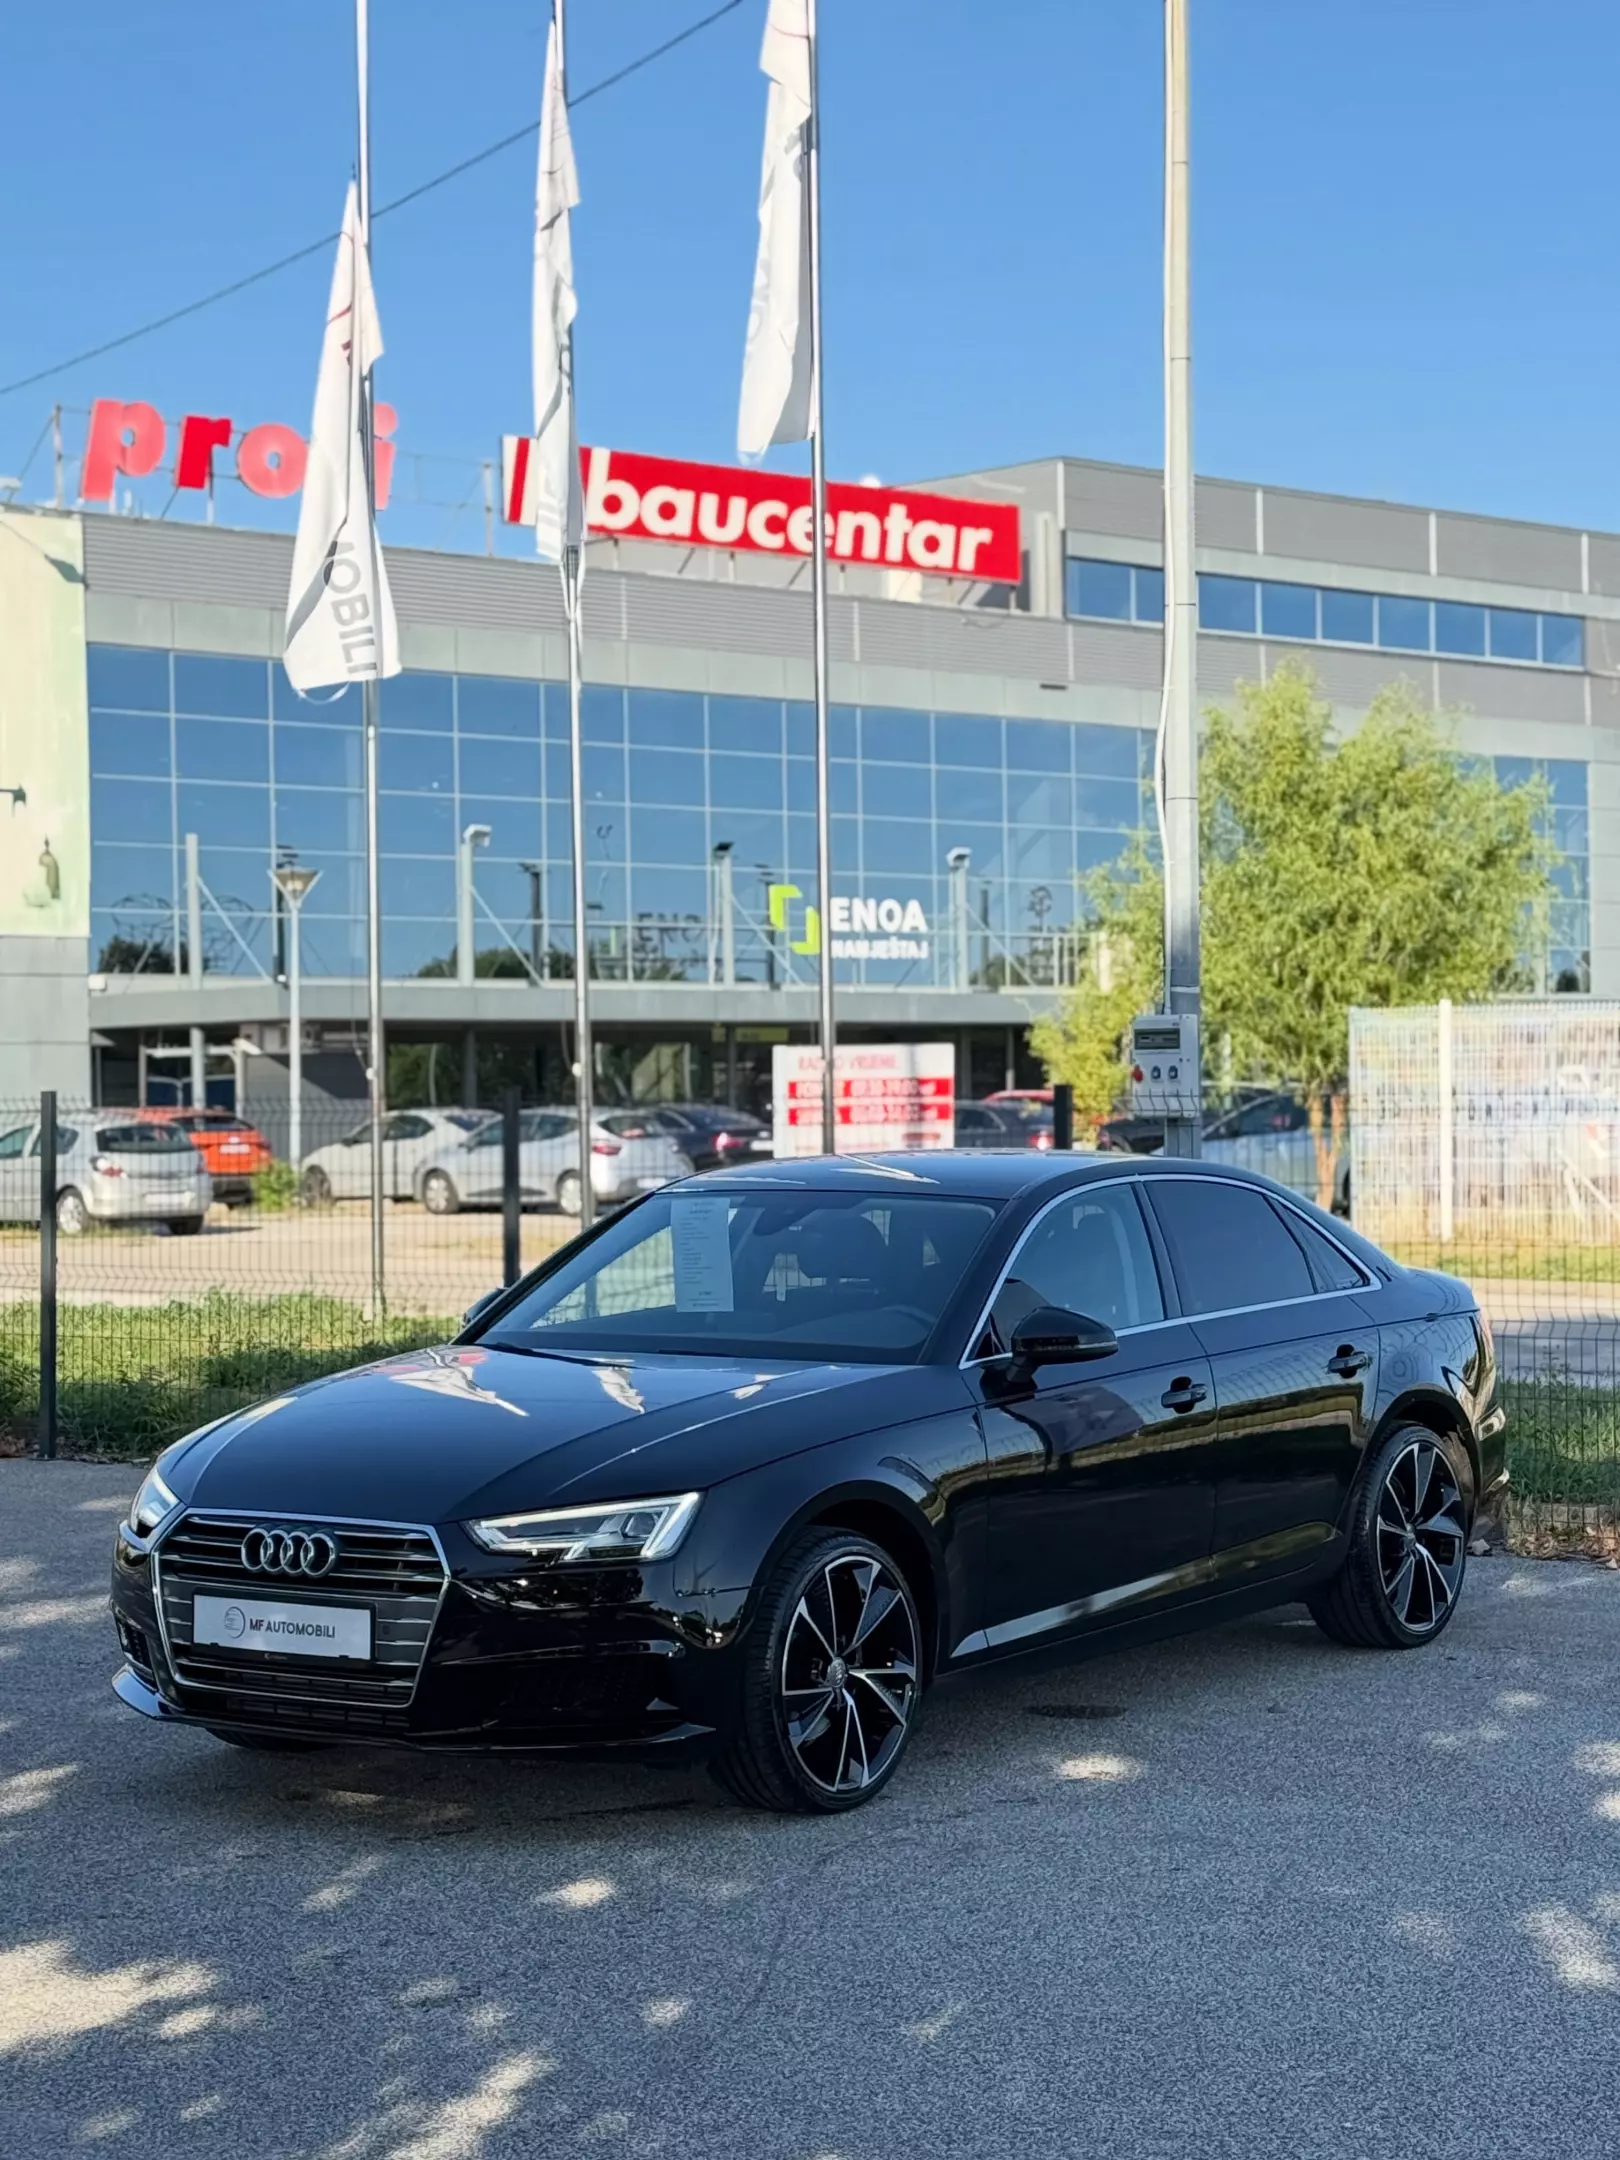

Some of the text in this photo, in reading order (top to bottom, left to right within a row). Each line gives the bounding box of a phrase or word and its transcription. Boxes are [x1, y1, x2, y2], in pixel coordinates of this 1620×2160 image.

[80, 398, 397, 511] proi
[586, 446, 993, 572] baucentar
[830, 897, 929, 933] ENOA
[249, 1618, 336, 1639] MF AUTOMOBILI
